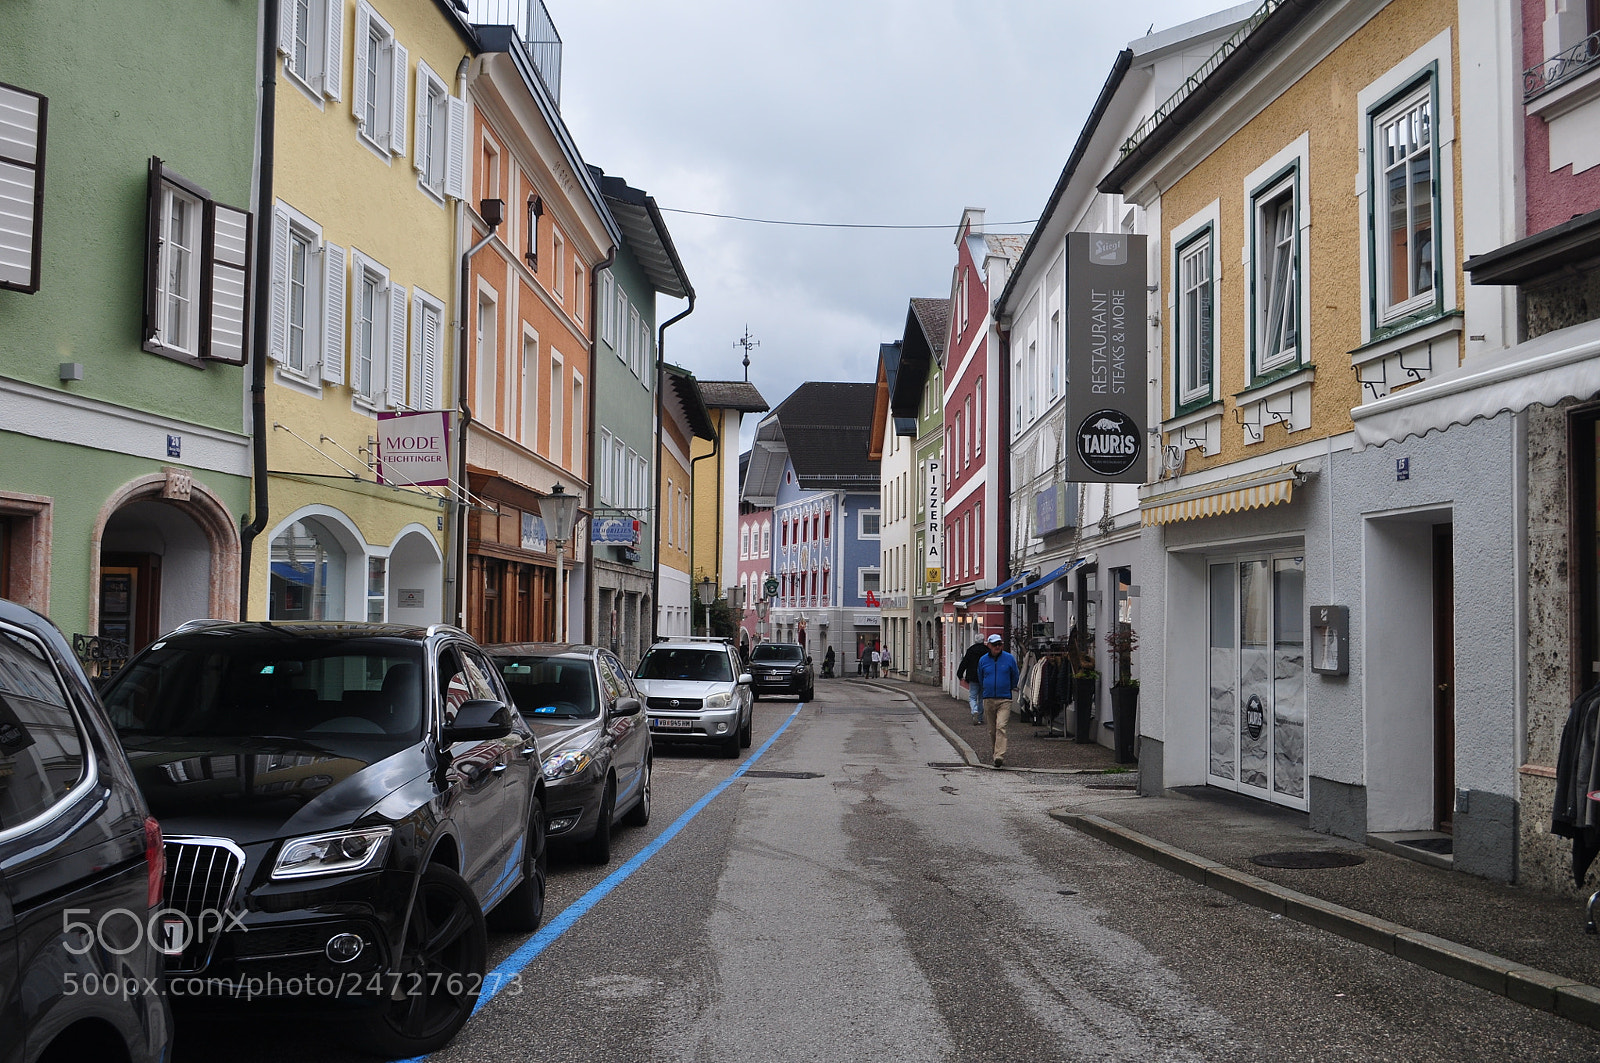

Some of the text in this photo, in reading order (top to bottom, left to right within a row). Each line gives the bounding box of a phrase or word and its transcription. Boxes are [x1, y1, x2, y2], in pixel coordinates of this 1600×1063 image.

[1095, 239, 1120, 255] Stiegl
[1091, 288, 1107, 394] RESTAURANT
[1112, 289, 1125, 394] STEAKS & MORE
[386, 436, 440, 450] MODE
[1082, 434, 1135, 455] TAURIS
[383, 455, 442, 463] FEICHTINGER
[929, 462, 939, 556] PIZZERIA
